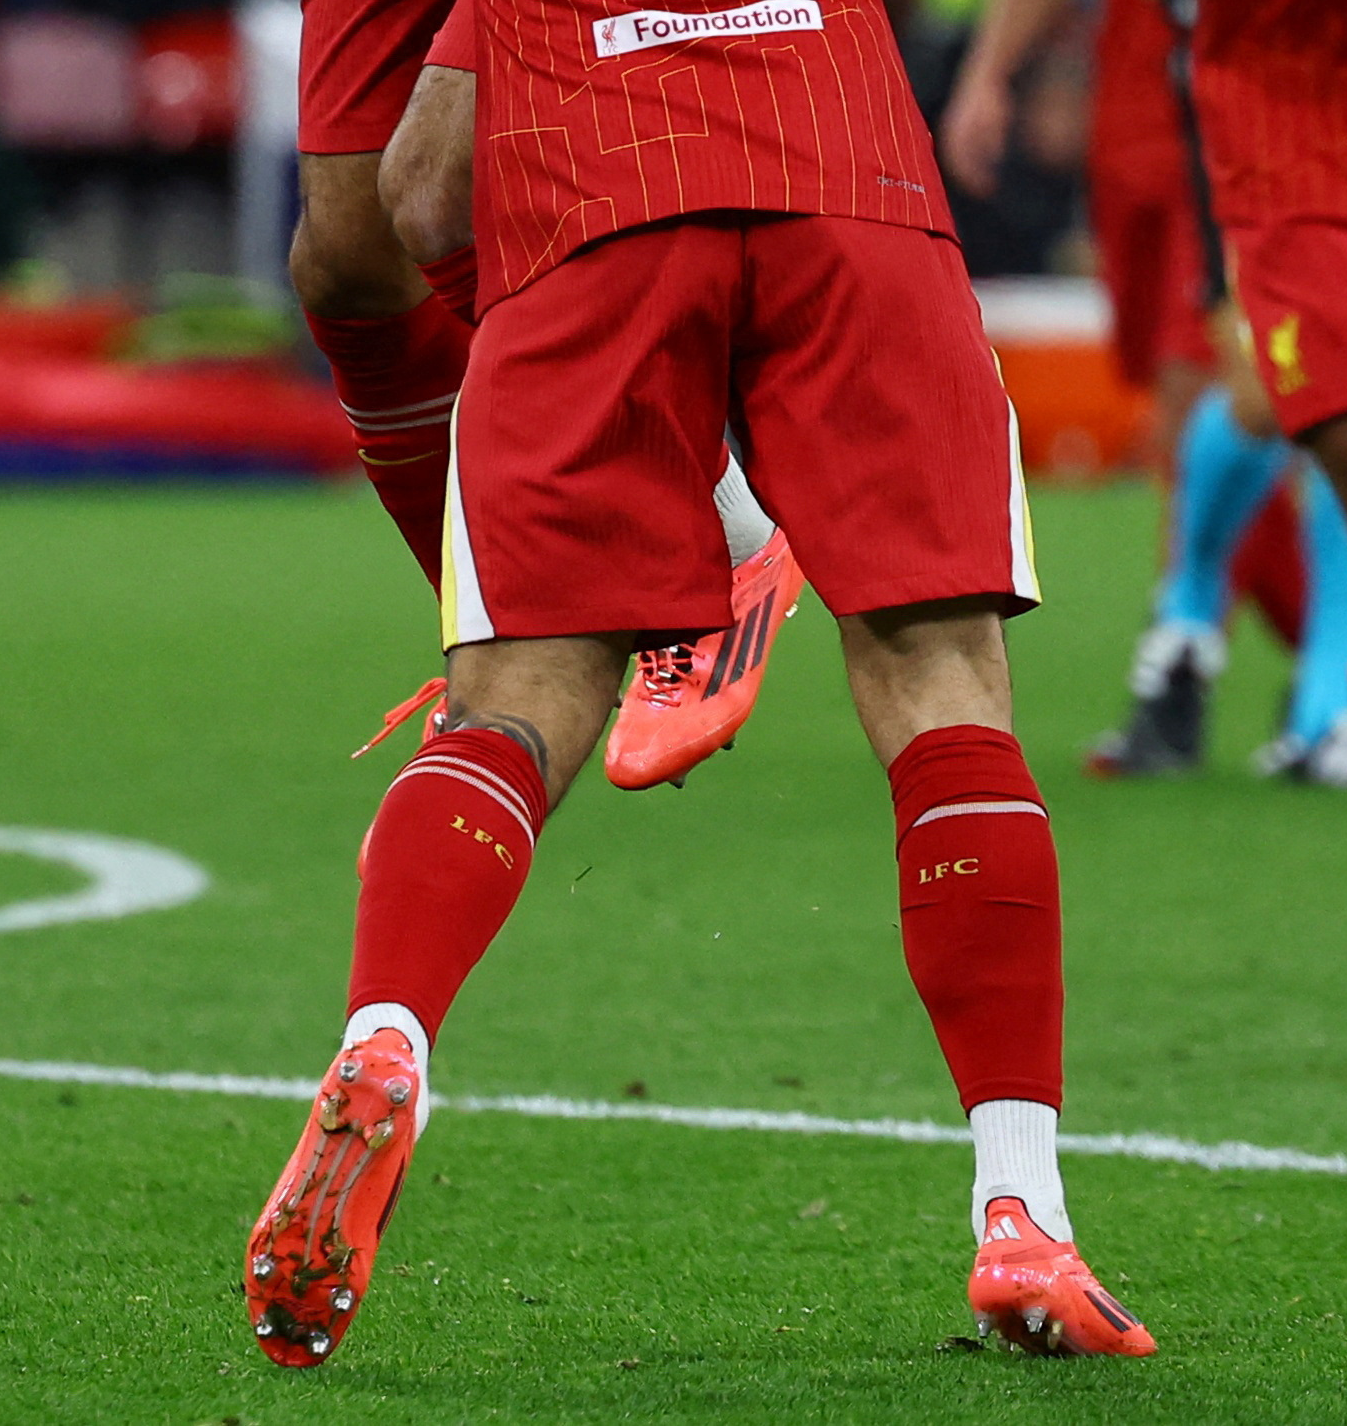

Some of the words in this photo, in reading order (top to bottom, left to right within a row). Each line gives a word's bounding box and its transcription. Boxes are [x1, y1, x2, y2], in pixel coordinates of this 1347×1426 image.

[633, 5, 812, 43] Foundation
[450, 814, 514, 870] LFC
[919, 858, 979, 885] LFC
